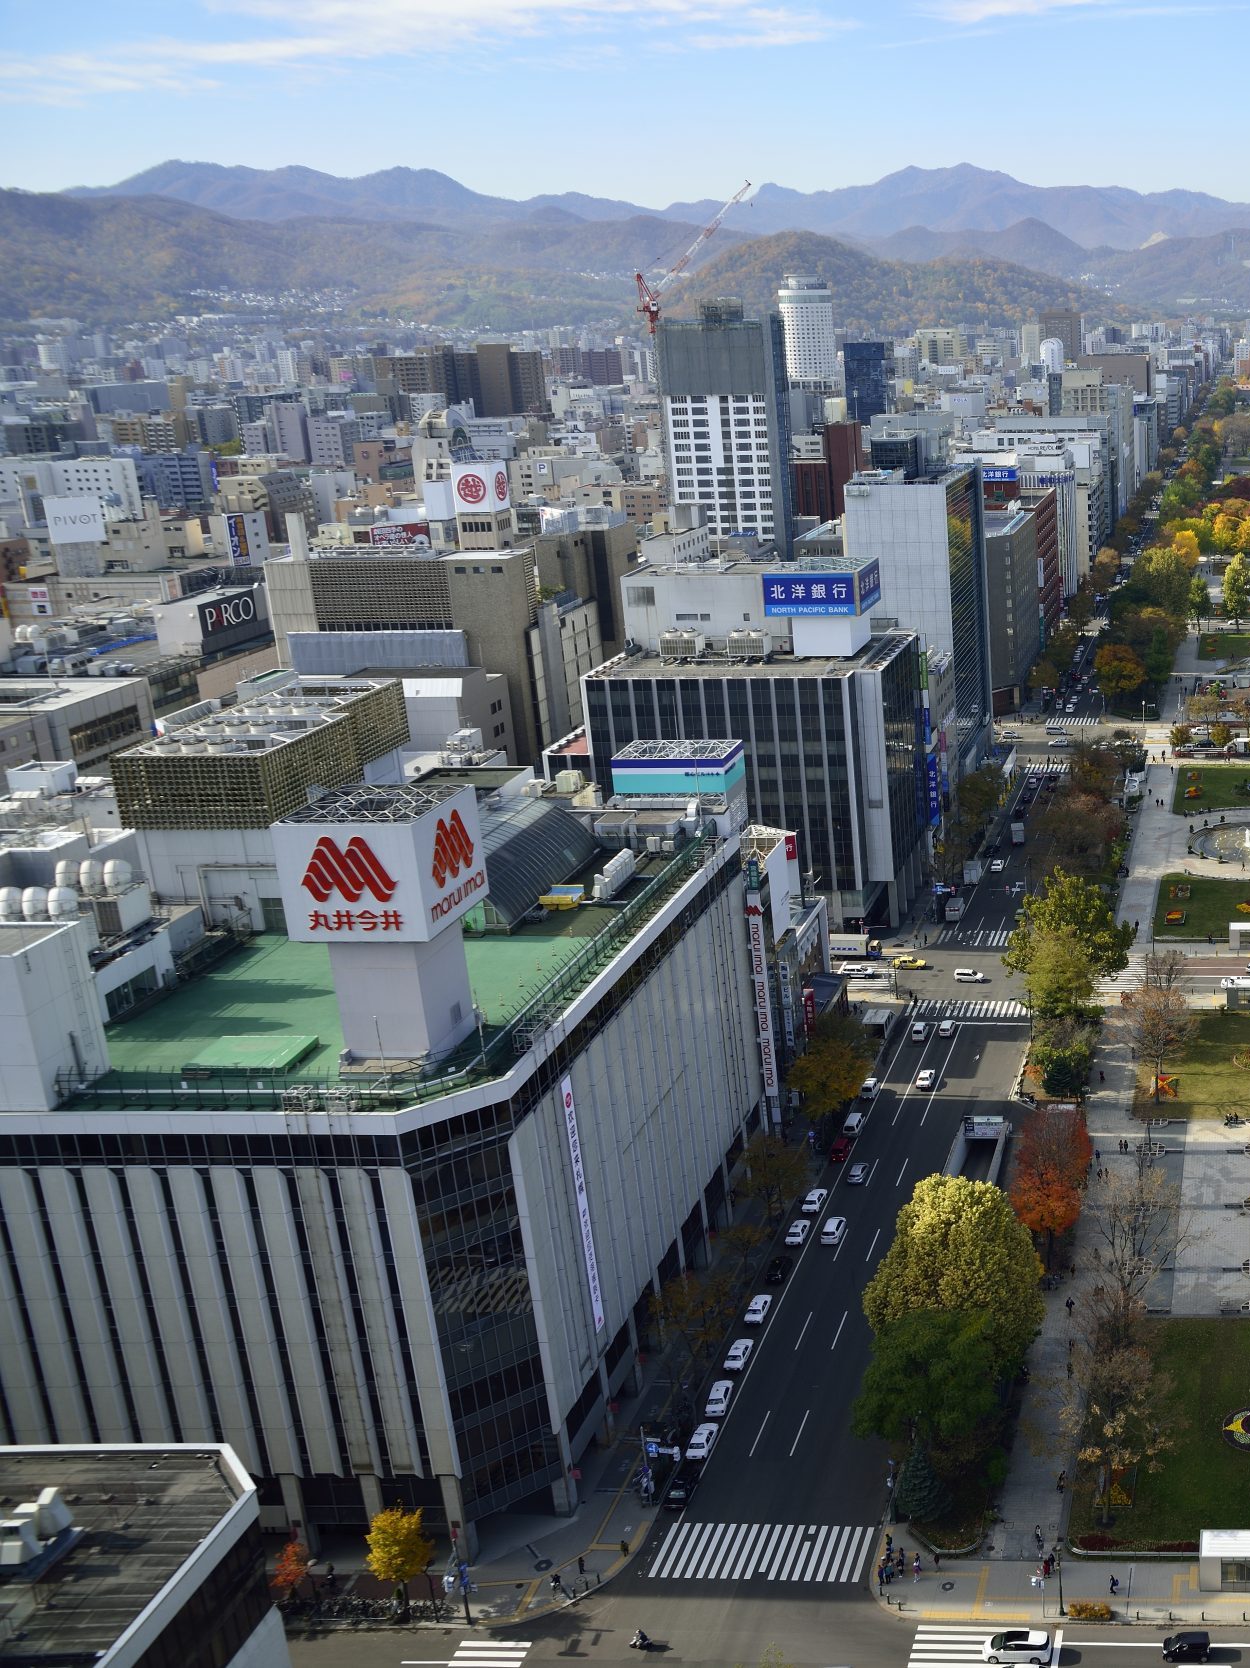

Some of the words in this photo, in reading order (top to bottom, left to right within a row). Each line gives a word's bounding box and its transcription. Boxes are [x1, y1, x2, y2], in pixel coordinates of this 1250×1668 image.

[53, 513, 98, 526] PIVOT
[770, 583, 847, 599] 北洋銀行
[204, 597, 254, 631] PARCO
[929, 770, 937, 808] 北洋銀行
[308, 910, 404, 931] 丸井今井
